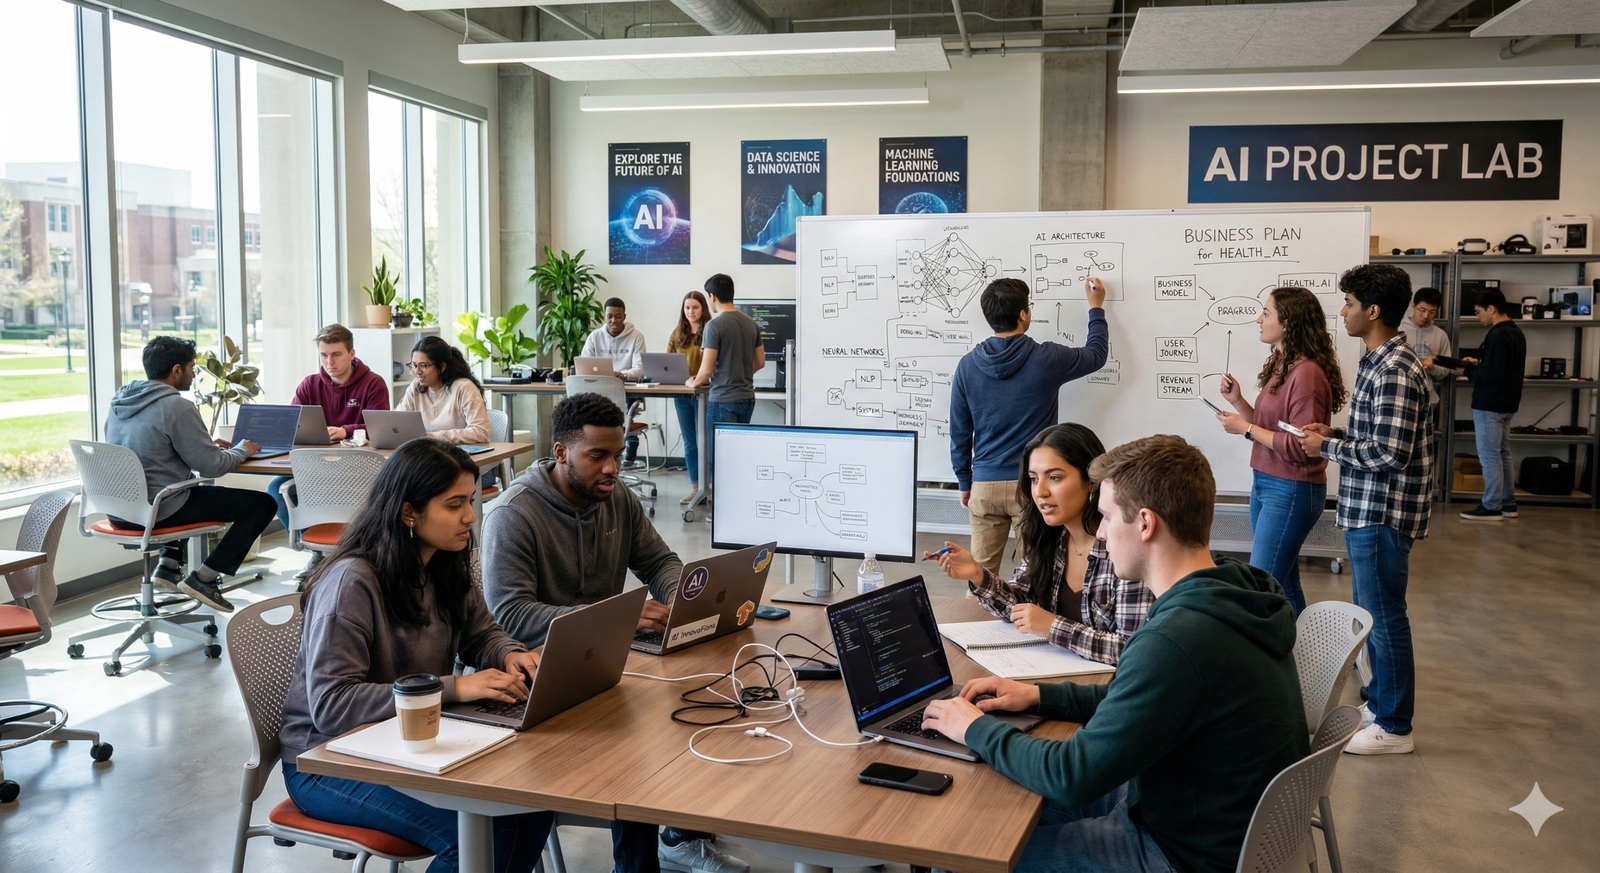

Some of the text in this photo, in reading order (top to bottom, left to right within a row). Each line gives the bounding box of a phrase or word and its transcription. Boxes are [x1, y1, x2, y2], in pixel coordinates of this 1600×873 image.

[615, 153, 682, 165] EXPLORE THE
[747, 151, 820, 162] DATA SCIENCE
[885, 148, 934, 160] MACHINE
[885, 160, 938, 171] LEARNING
[1203, 142, 1543, 182] AI PROJECT LAB
[615, 165, 682, 176] FUTURE OF AI
[747, 163, 820, 174] & INNOVATION
[885, 171, 960, 183] FOUNDATIONS
[633, 204, 663, 230] AI
[1036, 231, 1106, 241] AI ARCHITECTURE
[1184, 227, 1301, 243] BUSINESS PLAN
[1197, 246, 1288, 259] for HEALTH_AI
[1158, 280, 1193, 288] BUSINESS
[1283, 279, 1331, 288] HEALTH_AI
[1161, 289, 1189, 297] MODEL
[822, 348, 885, 356] NEURAL NETWORKS
[1159, 349, 1194, 360] JOURNEY
[860, 375, 876, 383] NLP
[1160, 375, 1194, 384] REVENUE
[1163, 386, 1193, 394] STREAM
[857, 406, 881, 414] SYSTEM
[687, 572, 703, 589] AI
